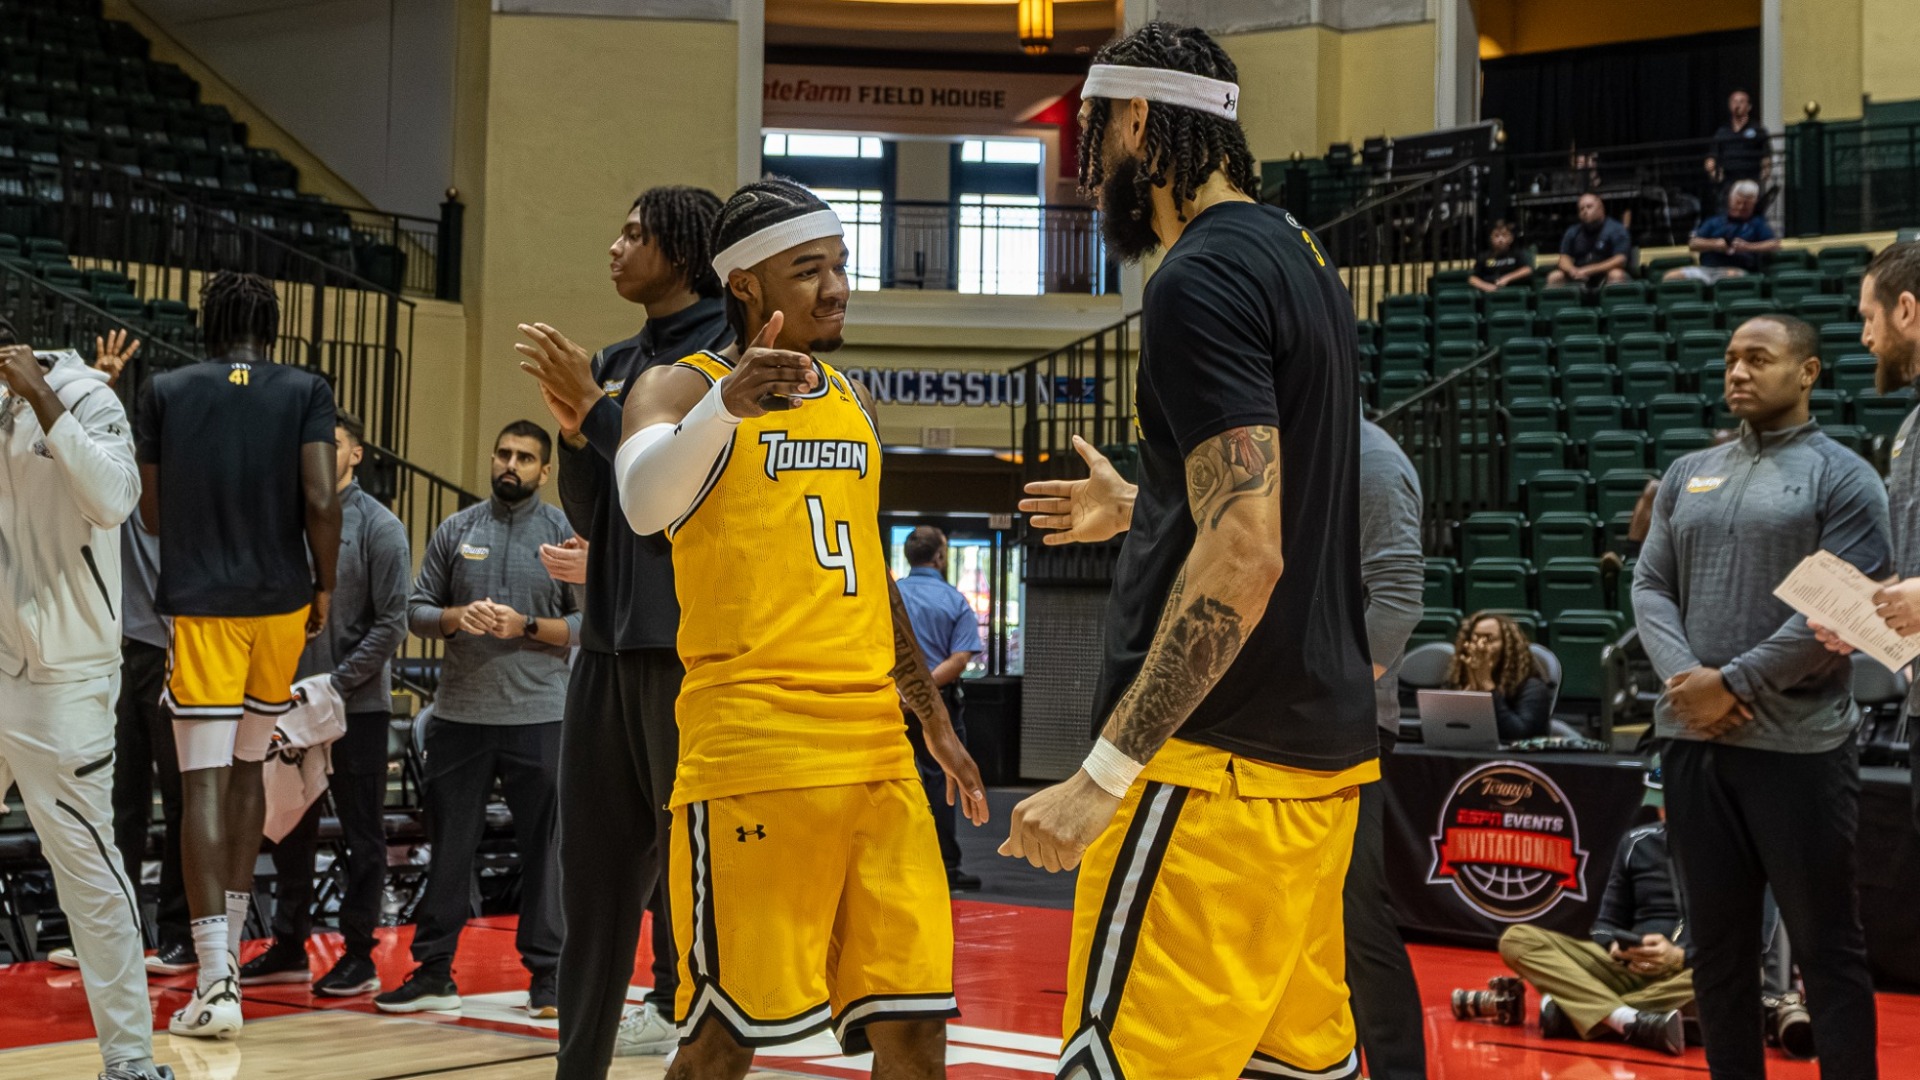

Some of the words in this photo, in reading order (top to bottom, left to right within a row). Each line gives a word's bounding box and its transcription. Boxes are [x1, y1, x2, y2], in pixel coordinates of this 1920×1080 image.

[858, 85, 924, 105] FIELD
[931, 88, 1006, 109] HOUSE
[228, 368, 249, 386] 41
[804, 495, 857, 597] 4
[1503, 812, 1564, 832] EVENTS
[1456, 831, 1566, 870] NVITATIONAL
